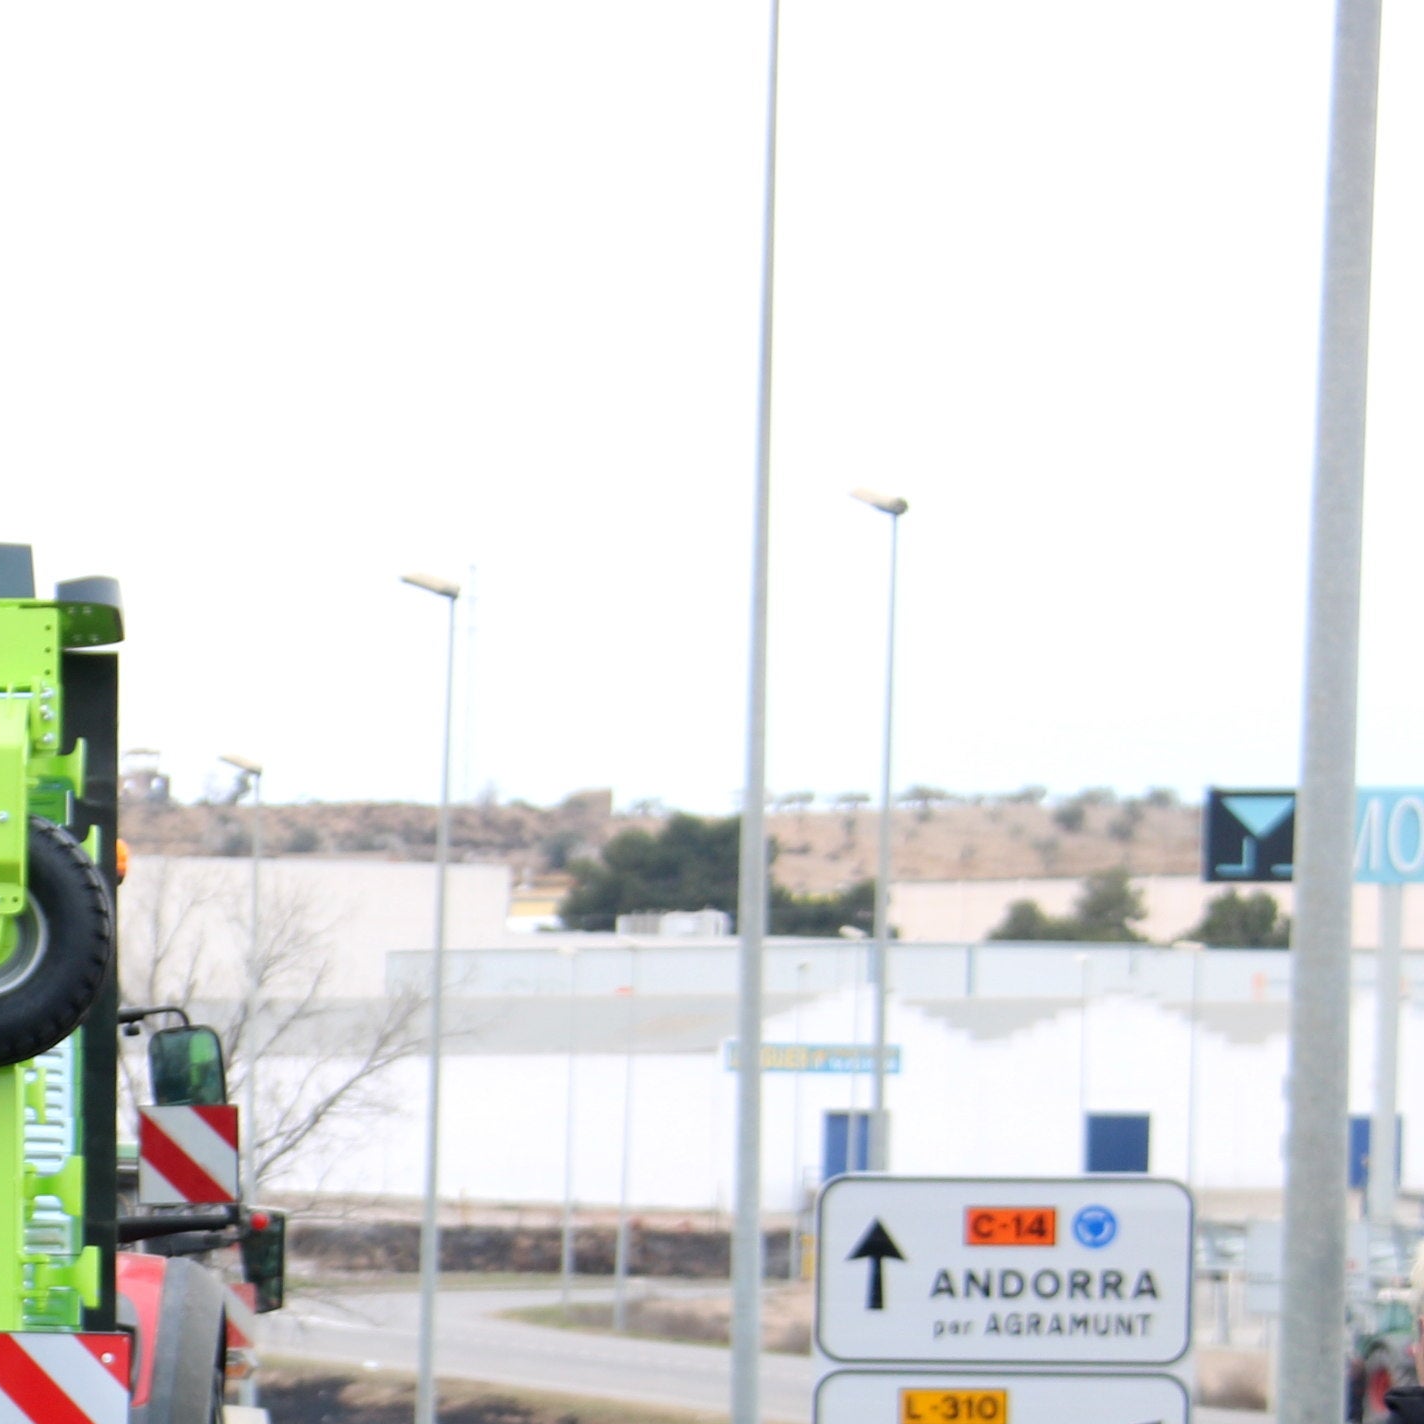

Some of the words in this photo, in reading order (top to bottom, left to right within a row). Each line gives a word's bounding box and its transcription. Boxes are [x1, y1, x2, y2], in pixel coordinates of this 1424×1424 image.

[971, 1213, 1048, 1240] C-14
[929, 1268, 1159, 1300] ANDORRA
[984, 1312, 1153, 1338] AGRAMUNT
